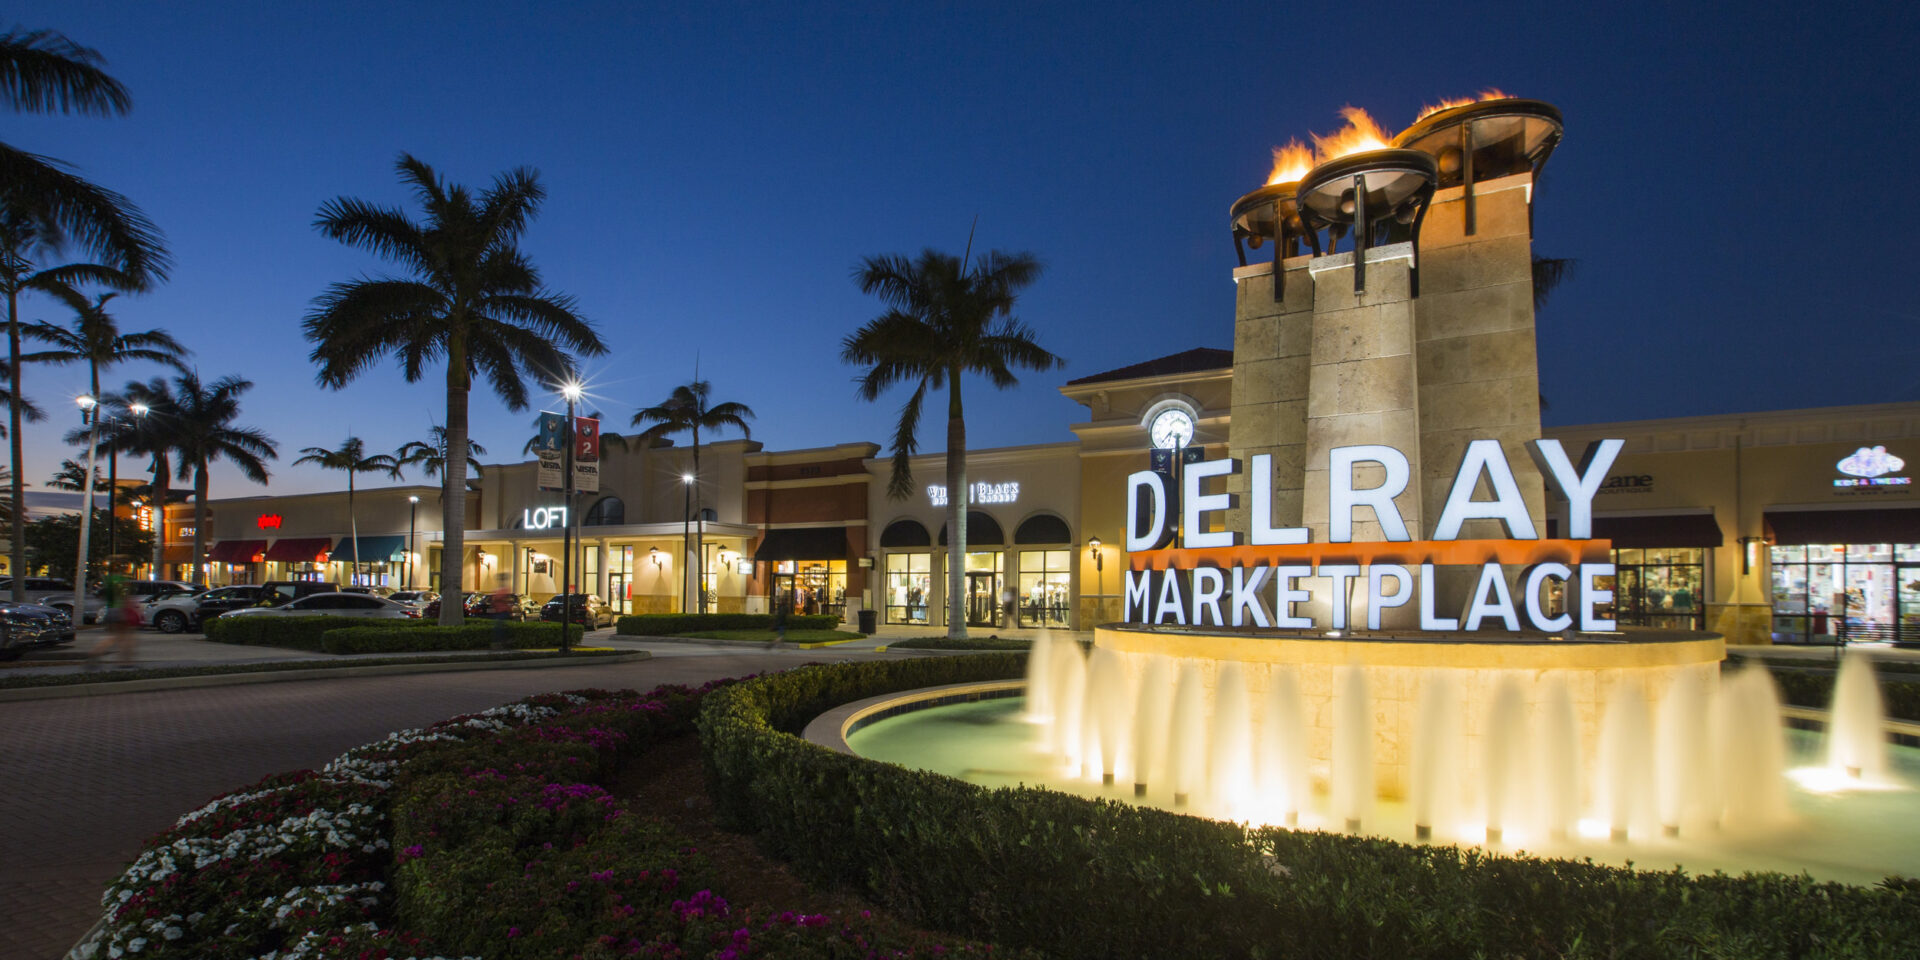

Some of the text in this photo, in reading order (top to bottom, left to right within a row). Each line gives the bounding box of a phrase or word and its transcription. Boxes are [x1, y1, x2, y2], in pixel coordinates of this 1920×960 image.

[547, 437, 555, 449] 4
[583, 442, 592, 454] 2
[576, 465, 598, 474] VISTA
[977, 482, 1019, 495] BLACK
[1833, 479, 1859, 487] KIDS
[978, 494, 1017, 503] MARKET
[1126, 439, 1625, 552] DELRAY
[524, 506, 567, 529] LOFT
[1124, 562, 1617, 632] MARKETPLACE
